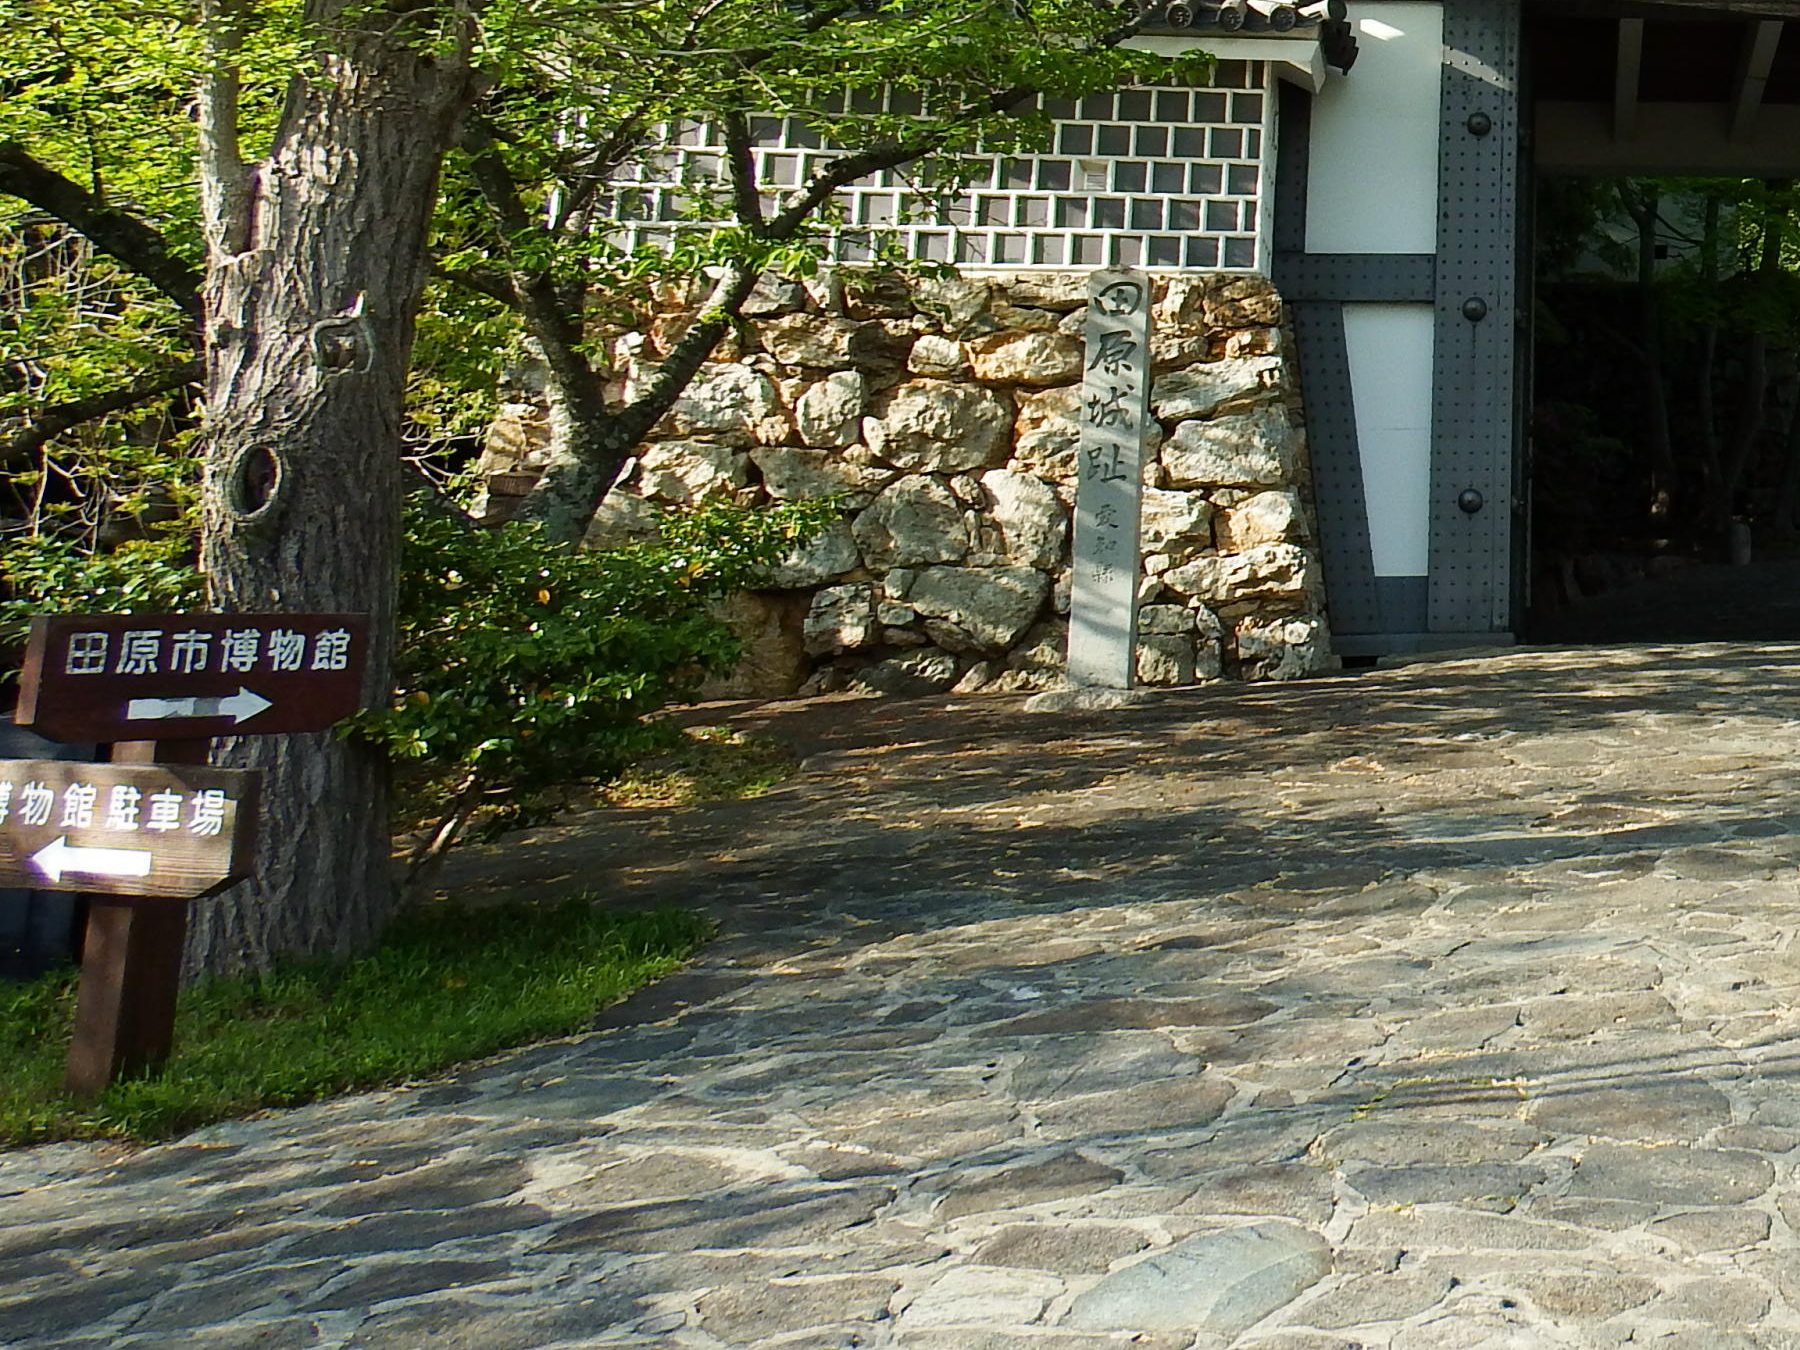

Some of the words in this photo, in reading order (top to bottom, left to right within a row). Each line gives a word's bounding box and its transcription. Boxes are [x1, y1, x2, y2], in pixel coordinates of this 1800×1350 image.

[66, 628, 351, 675] 田原市博物館
